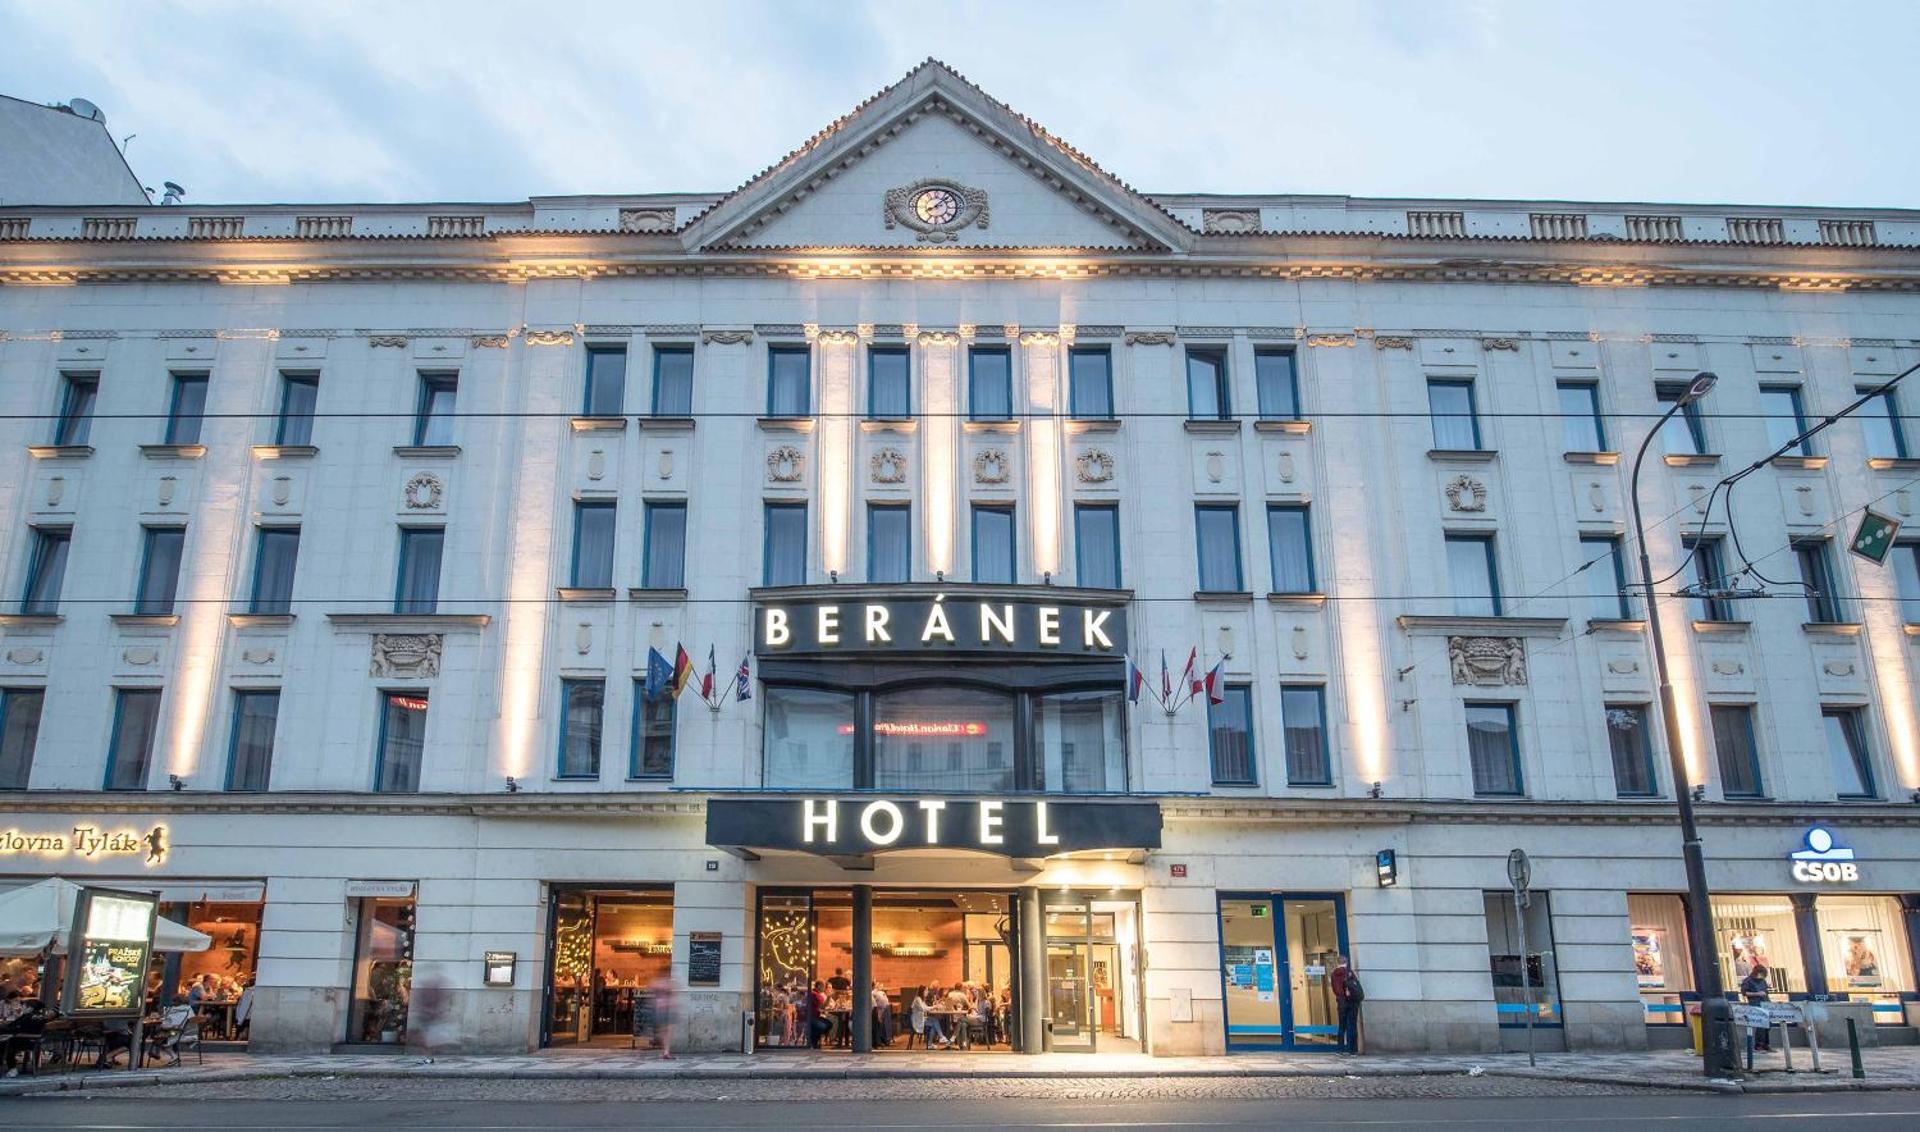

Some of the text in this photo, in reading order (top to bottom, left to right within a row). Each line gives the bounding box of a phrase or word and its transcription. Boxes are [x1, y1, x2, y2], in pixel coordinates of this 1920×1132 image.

[765, 593, 1114, 648] BERÁNEK
[803, 799, 1060, 845] HOTEL
[73, 827, 137, 856] Tylák
[1793, 860, 1858, 882] ČSOB
